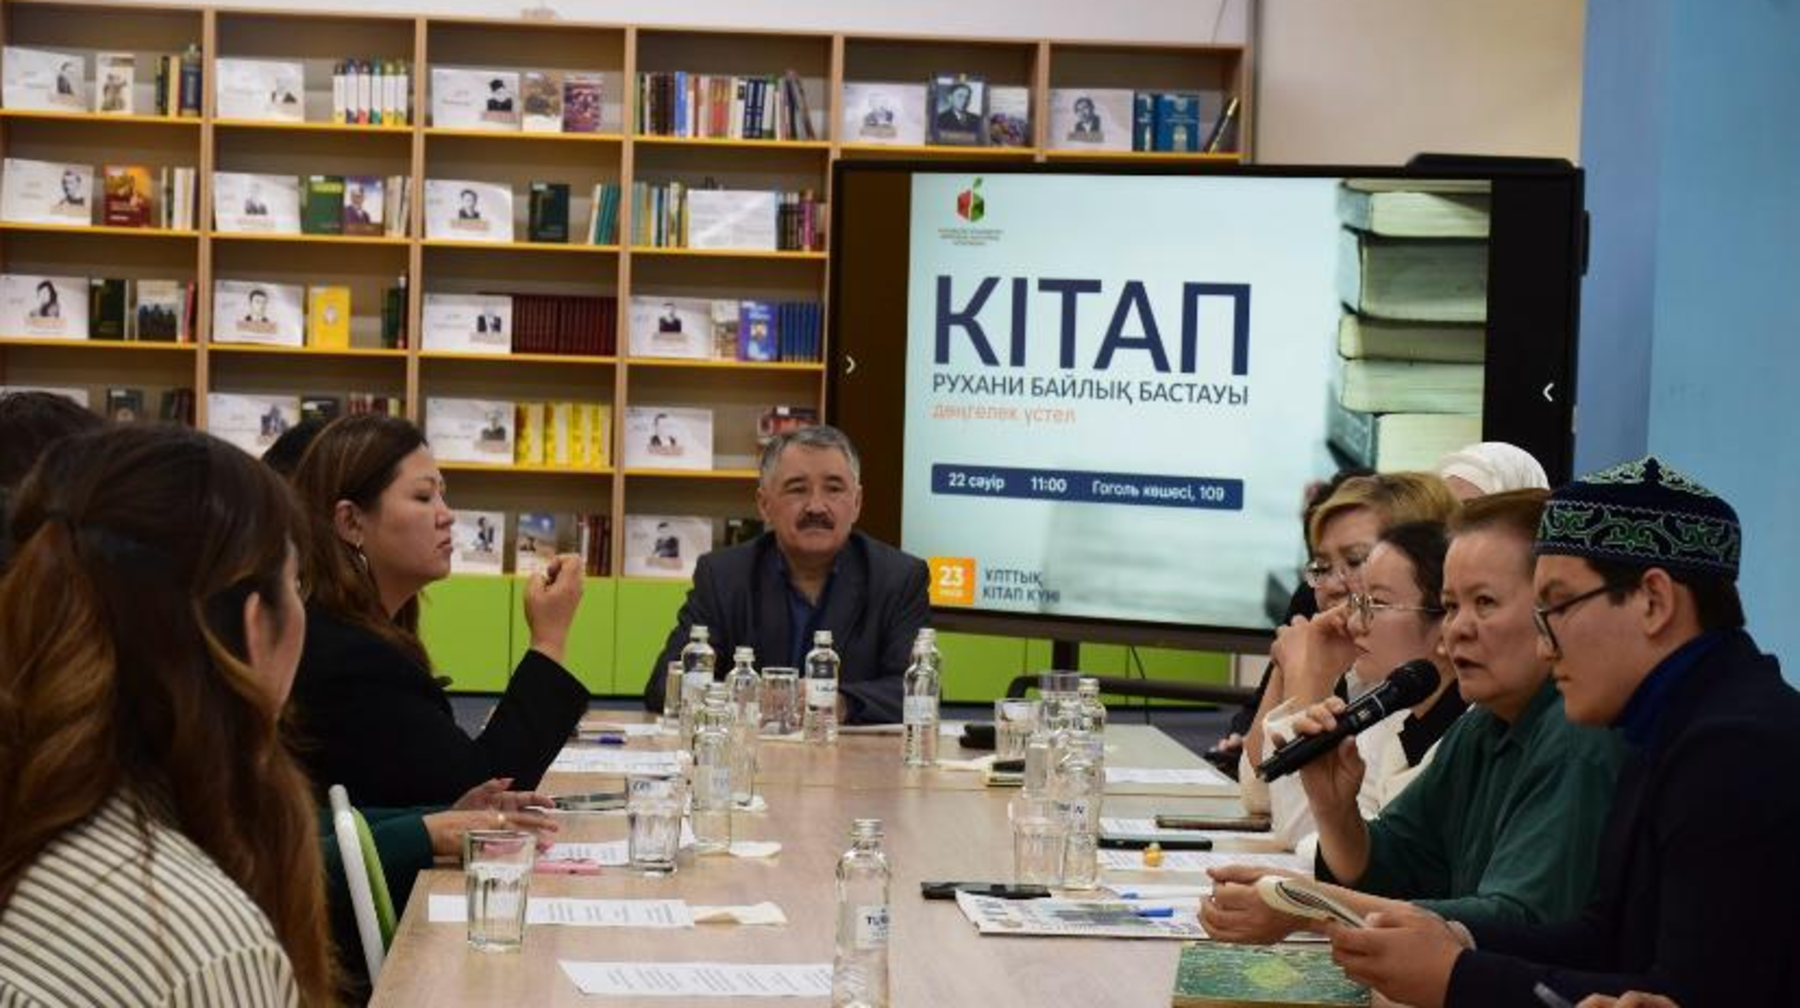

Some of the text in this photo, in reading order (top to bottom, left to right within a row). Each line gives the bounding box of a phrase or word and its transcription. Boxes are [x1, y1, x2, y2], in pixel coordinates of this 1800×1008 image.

[933, 275, 1252, 376] КІТАП
[932, 373, 1249, 405] РУХАНИ БАЙЛЫҚ БАСТАУЫ
[947, 472, 966, 487] 22
[1030, 476, 1068, 493] 11:00
[1092, 480, 1140, 498] Гоголь
[1199, 485, 1225, 502] 109
[939, 564, 965, 588] 23
[982, 586, 1024, 602] КІТАП
